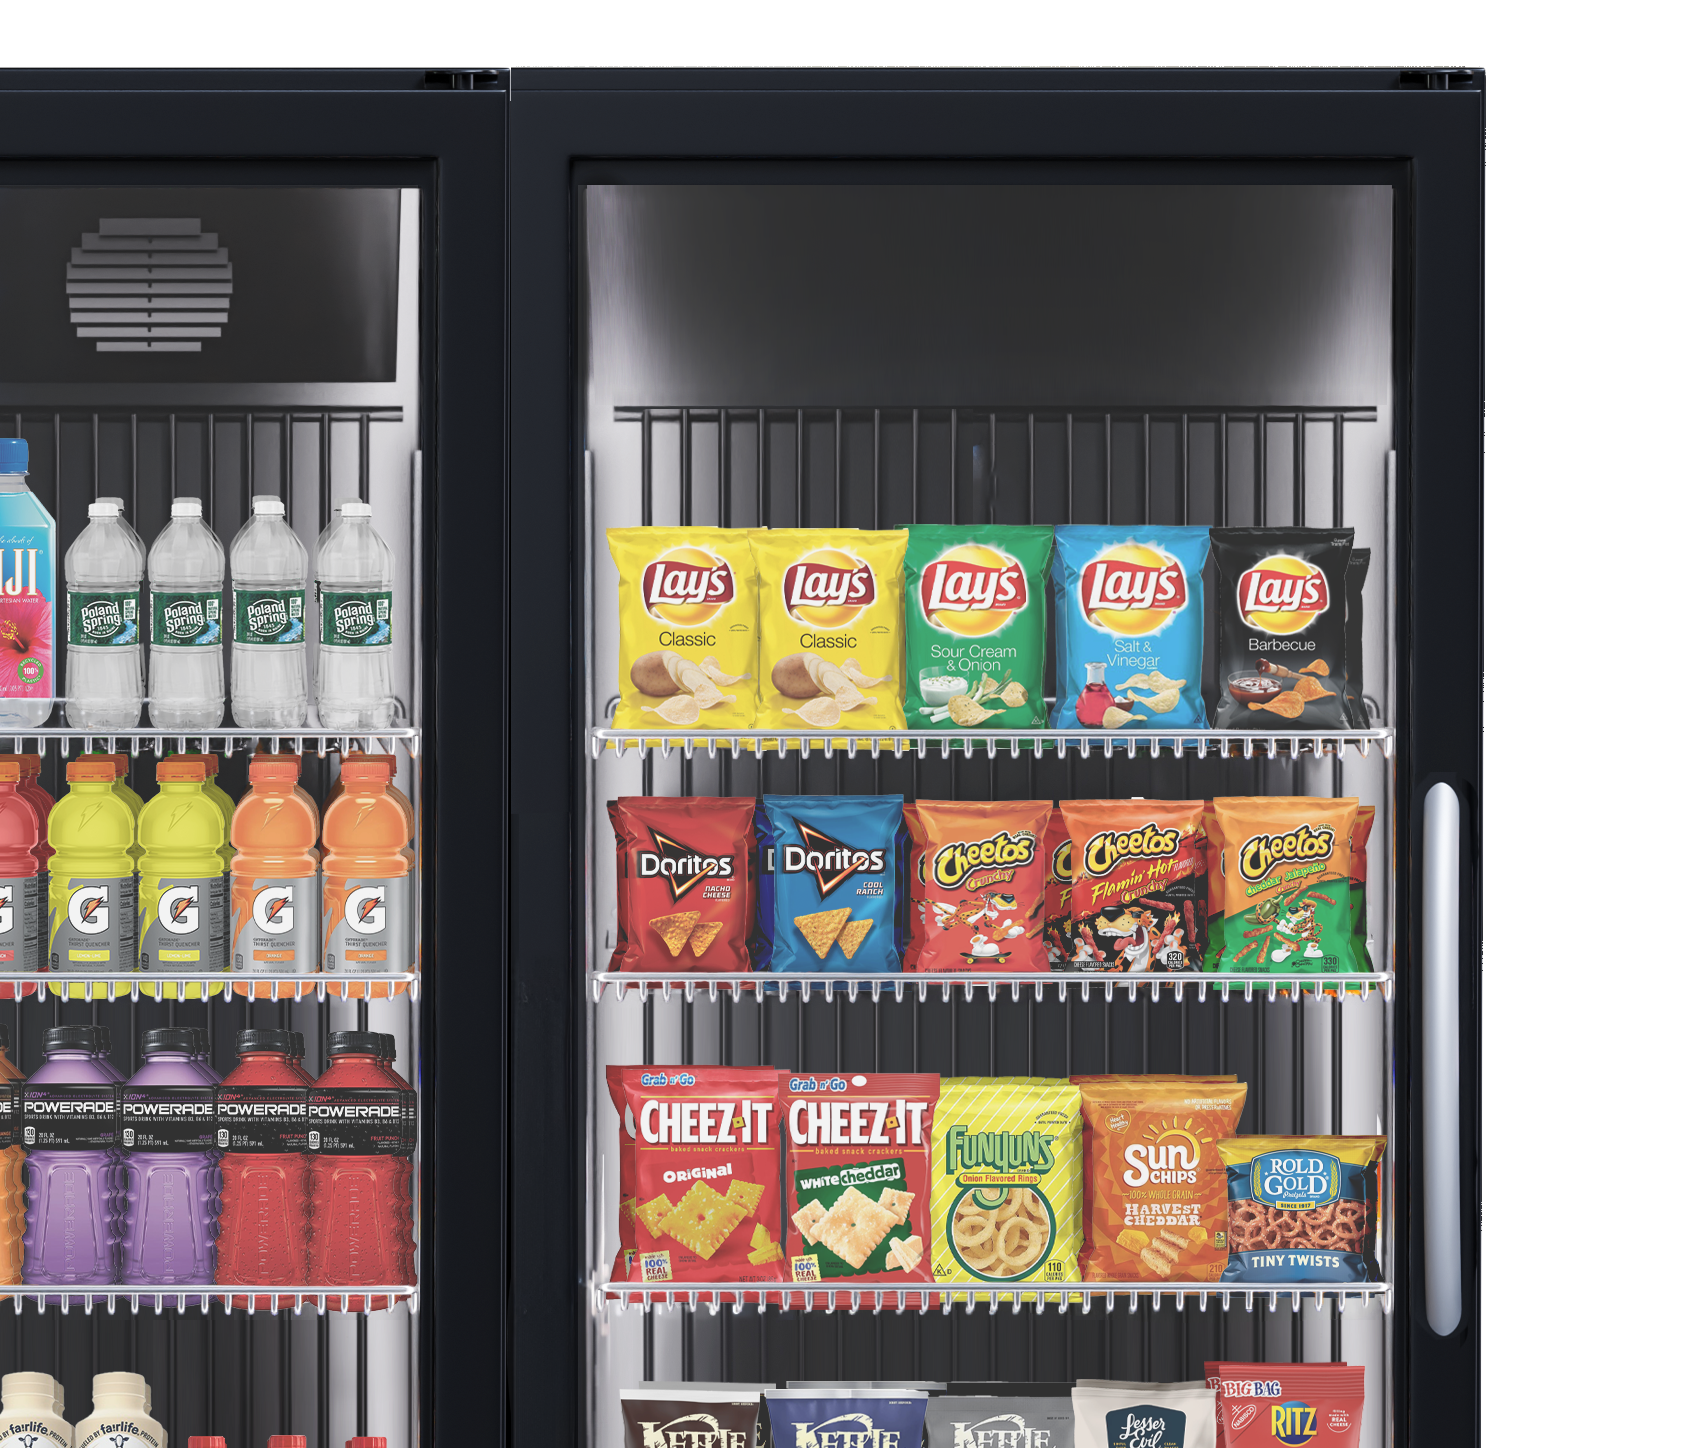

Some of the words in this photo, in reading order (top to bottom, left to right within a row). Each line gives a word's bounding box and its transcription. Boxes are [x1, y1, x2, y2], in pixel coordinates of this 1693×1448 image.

[649, 563, 727, 605] Lay's
[928, 563, 1019, 611] Lay's
[1244, 572, 1322, 613] Lay's
[81, 601, 119, 620] Poland
[334, 601, 373, 620] Poland
[83, 614, 122, 633] Spring
[336, 614, 374, 633] Spring
[659, 631, 716, 647] Classic
[1114, 640, 1140, 653] Salt
[1142, 641, 1152, 652] &
[1249, 638, 1316, 651] Barbecue
[1107, 655, 1160, 670] Vinegar
[1242, 827, 1333, 878] Cheetos
[641, 853, 732, 876] Doritos
[1246, 876, 1281, 897] Cheddar
[68, 885, 110, 935] G
[252, 885, 294, 935] G
[24, 1101, 114, 1113] POWERADE
[308, 1106, 400, 1118] POWERADE
[1270, 1159, 1323, 1175] ROLD
[1150, 1171, 1197, 1184] CHIPS
[1264, 1175, 1327, 1195] GOLD
[1252, 1255, 1285, 1268] TINY
[1288, 1255, 1340, 1268] TWISTS
[1271, 1405, 1318, 1437] RITZ
